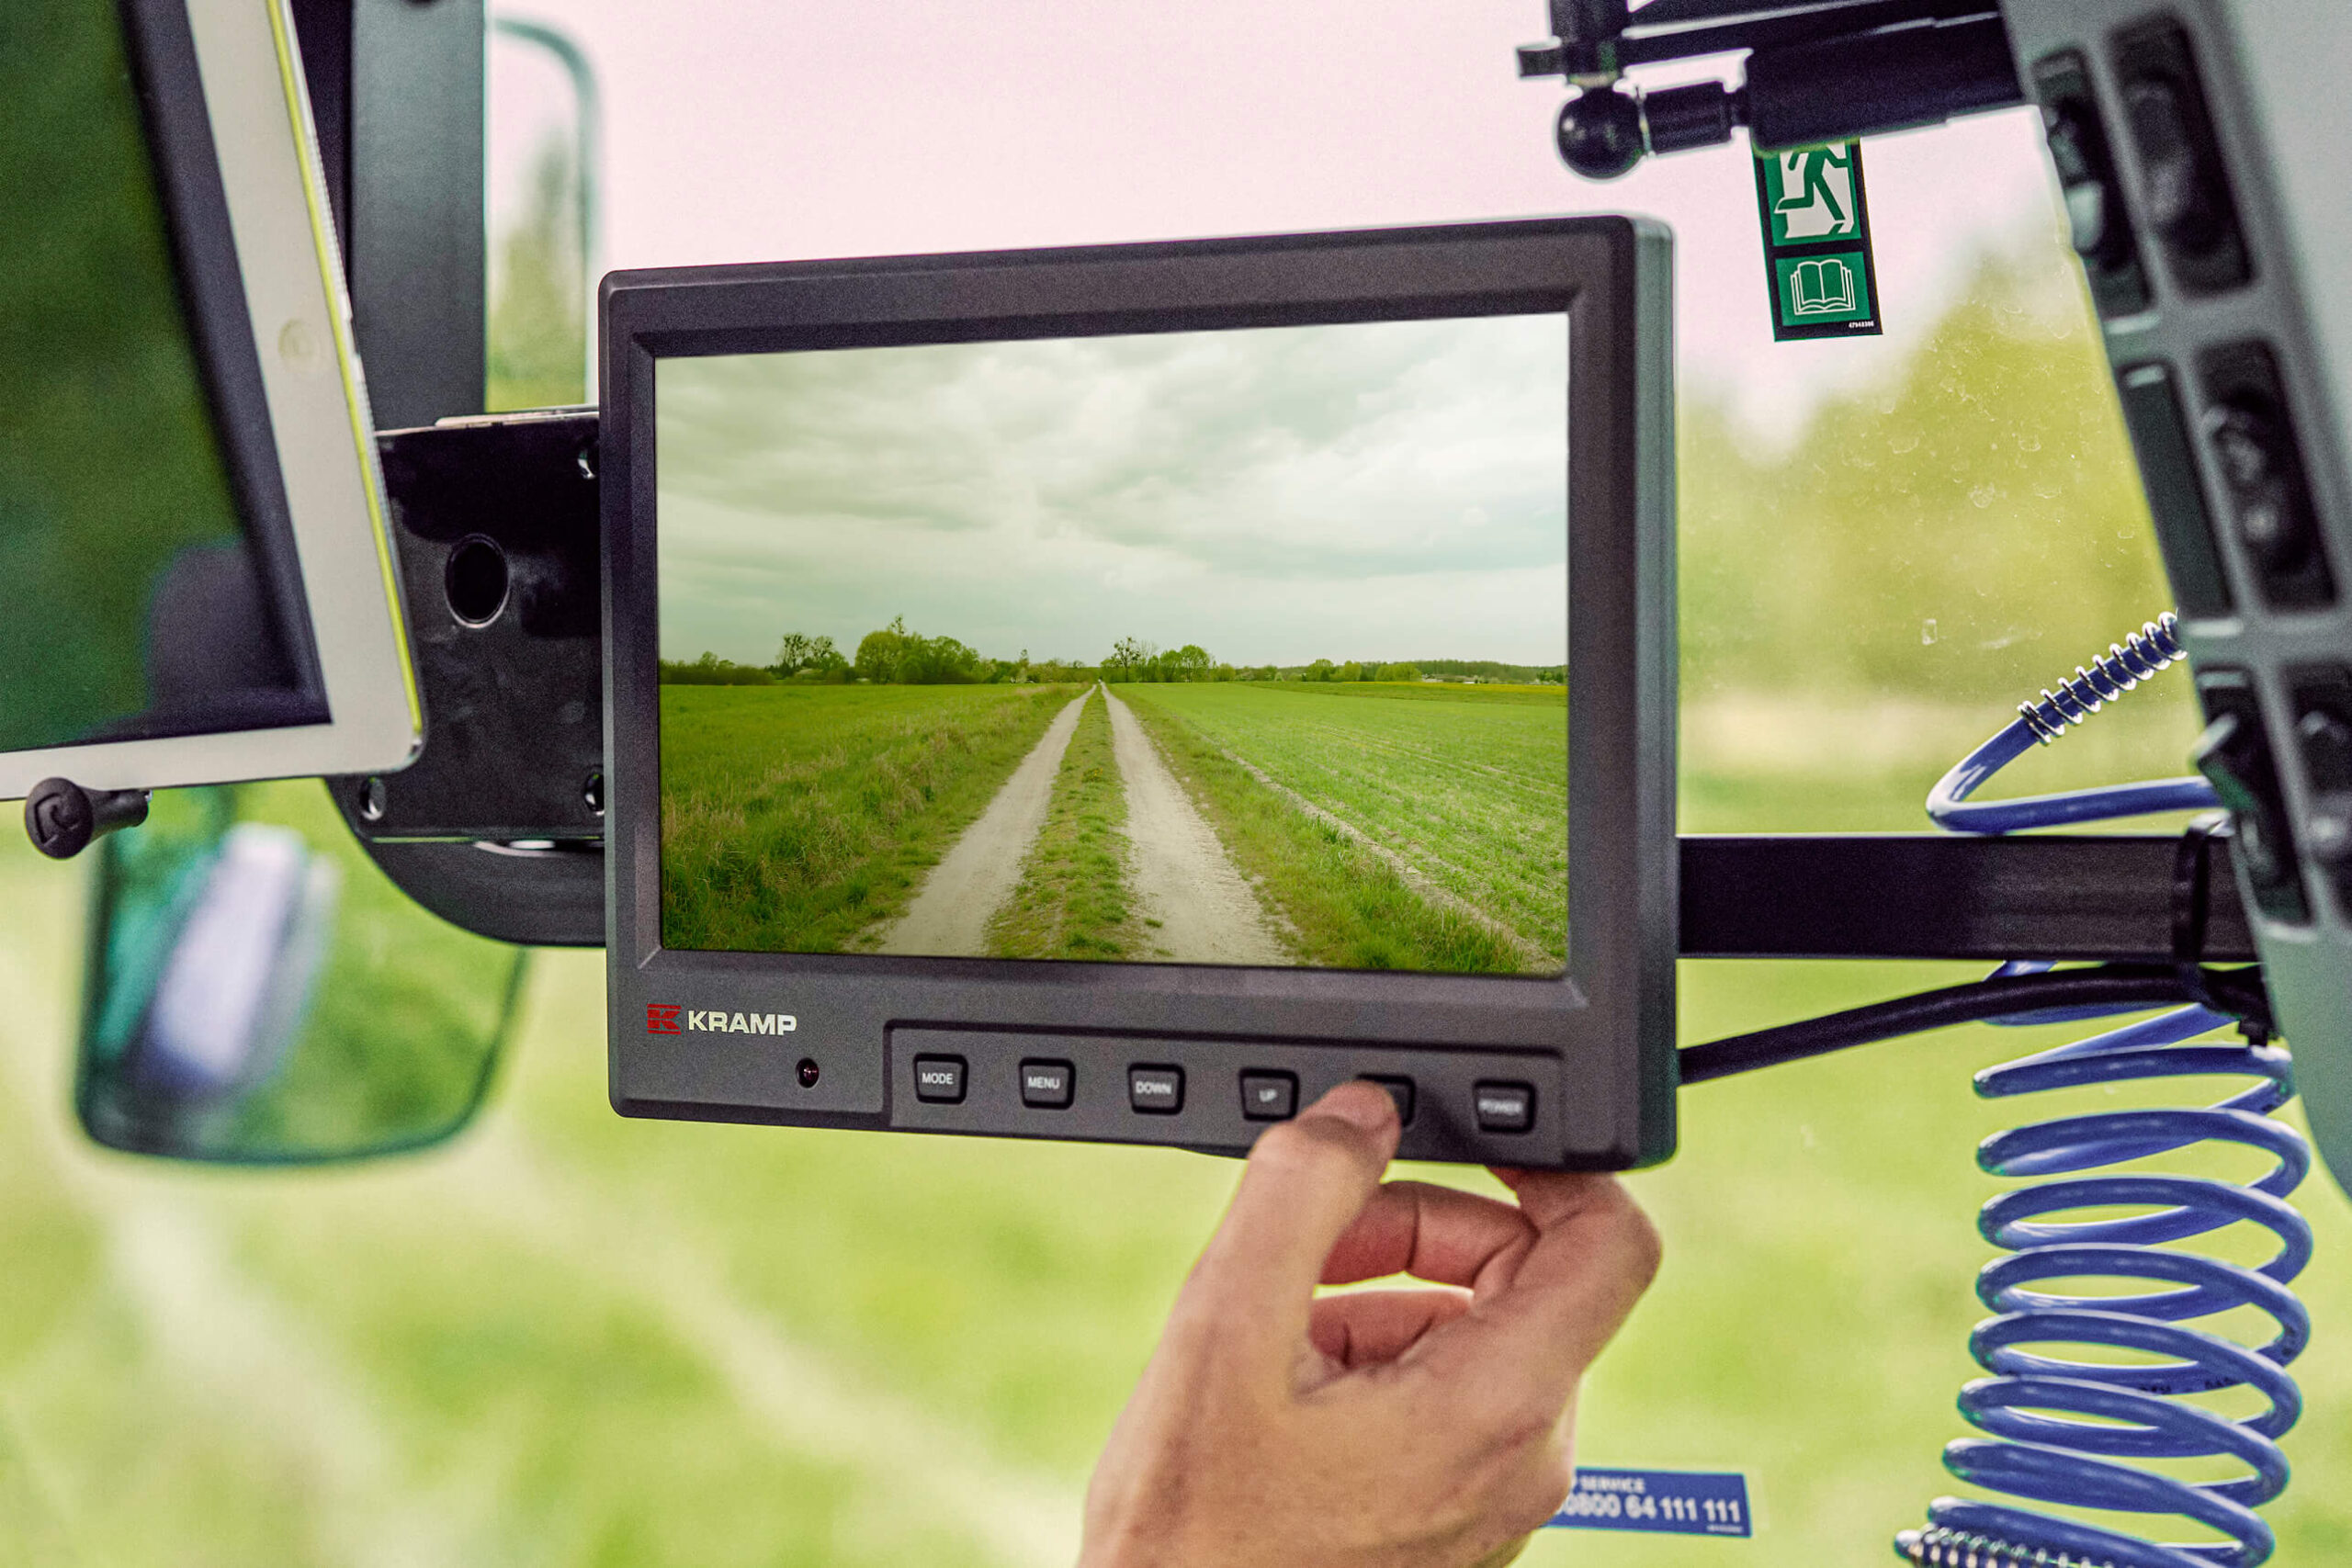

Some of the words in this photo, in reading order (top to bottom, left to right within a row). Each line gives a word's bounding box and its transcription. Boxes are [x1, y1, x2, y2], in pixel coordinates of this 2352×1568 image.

[687, 1010, 797, 1036] KRAMP
[922, 1071, 955, 1086] MODE
[1027, 1076, 1060, 1091] MENU
[1136, 1080, 1172, 1096] DOWN
[1259, 1089, 1278, 1102] UP
[1579, 1475, 1645, 1495] SERVICE
[1624, 1495, 1657, 1520] 64
[1659, 1496, 1698, 1522] 111
[1702, 1498, 1741, 1523] 111
